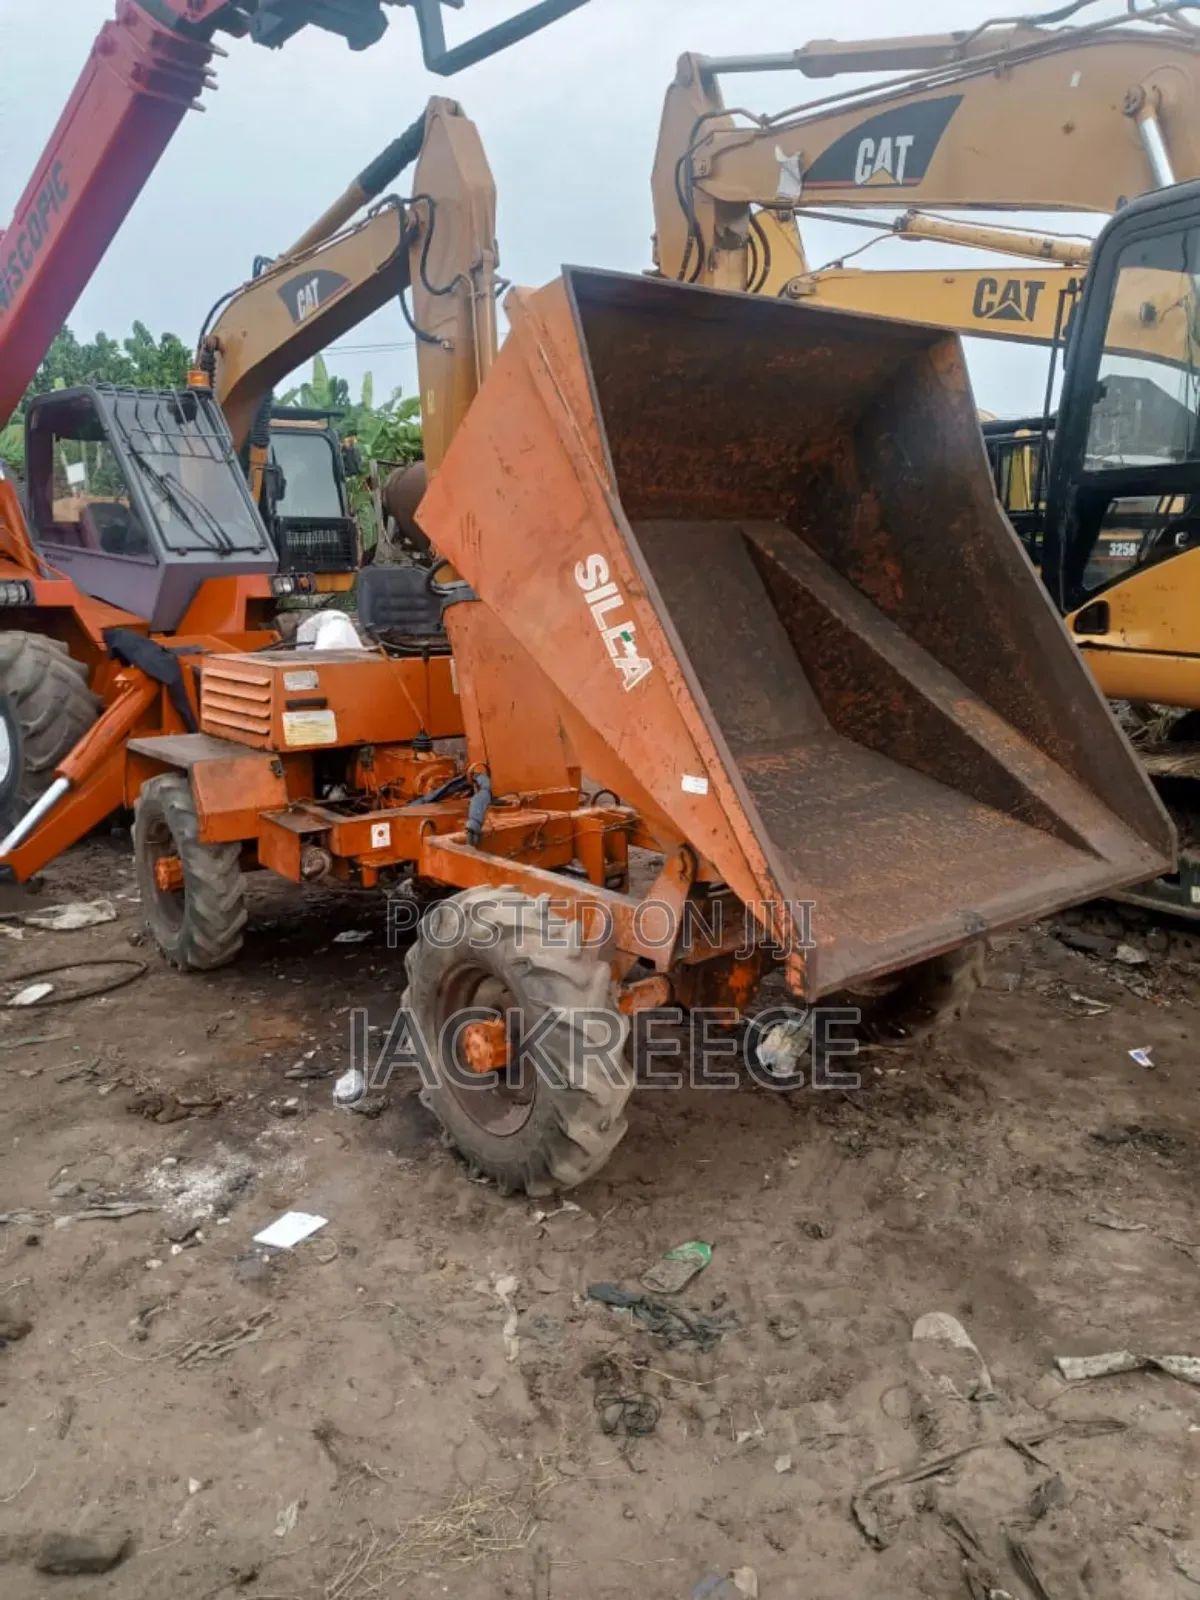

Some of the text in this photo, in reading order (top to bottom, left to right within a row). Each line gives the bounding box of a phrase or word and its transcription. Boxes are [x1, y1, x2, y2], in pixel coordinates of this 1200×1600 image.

[855, 135, 914, 185] CAT
[297, 277, 320, 321] CAT
[973, 277, 1046, 322] CAT
